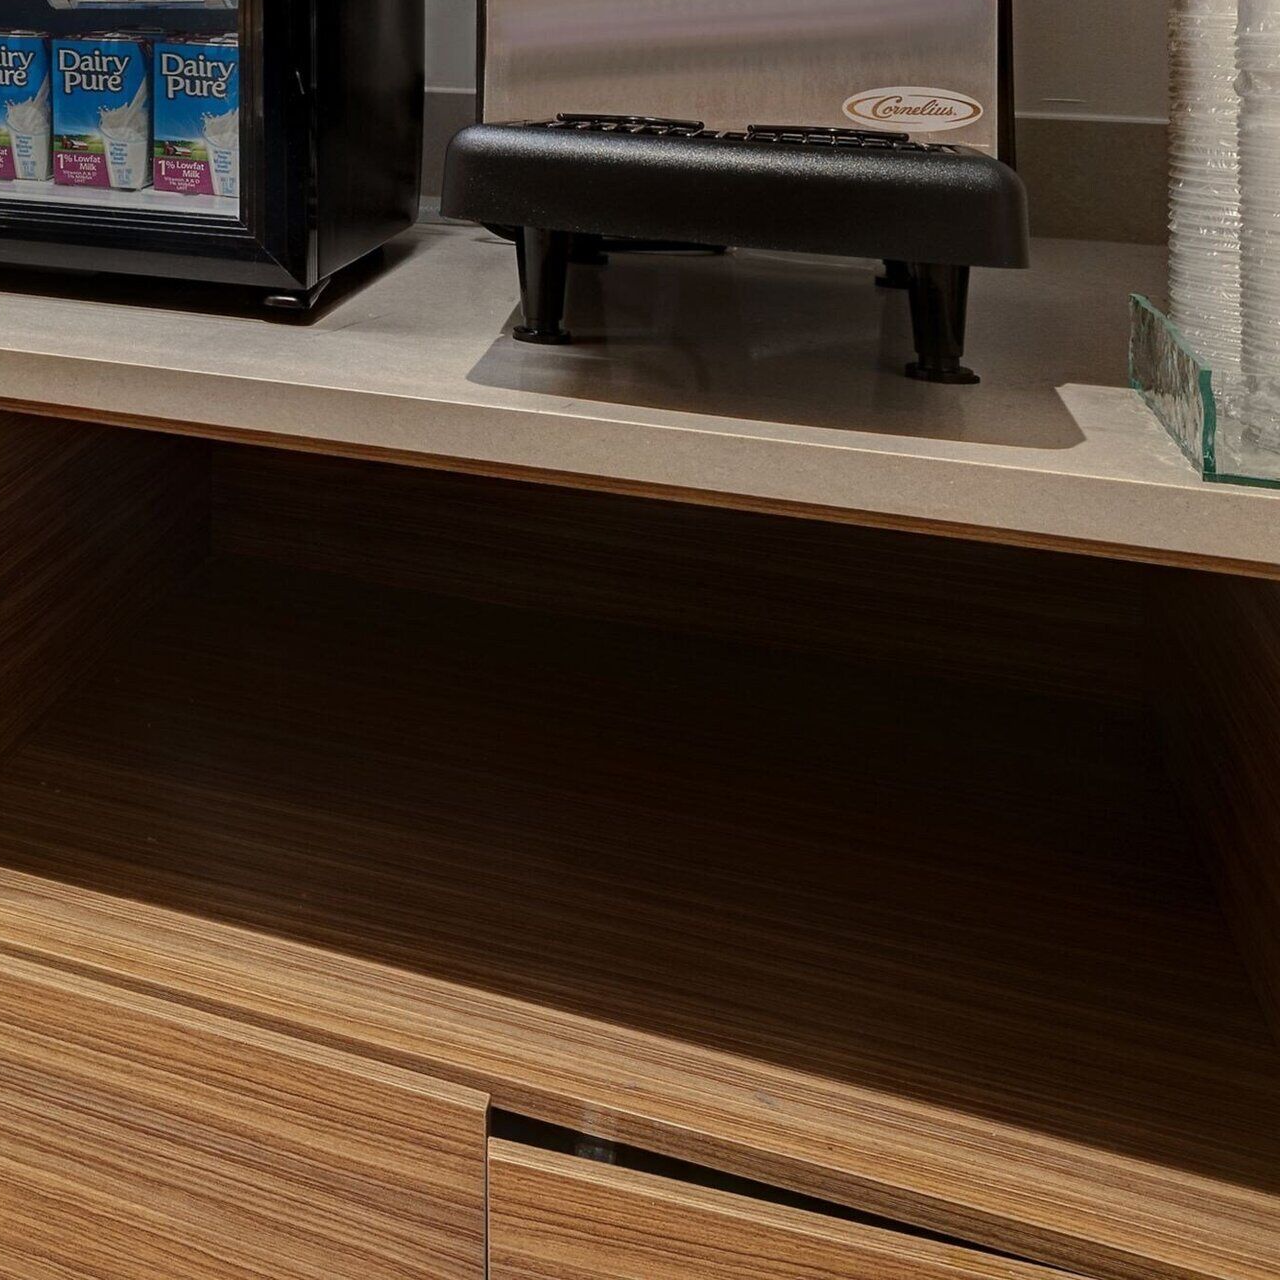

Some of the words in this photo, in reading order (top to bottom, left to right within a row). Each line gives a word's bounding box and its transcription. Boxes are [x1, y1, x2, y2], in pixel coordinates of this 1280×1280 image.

[59, 49, 129, 75] Dairy
[161, 53, 234, 81] Dairy
[64, 71, 122, 94] Pure
[167, 76, 226, 99] Pure
[57, 153, 73, 169] 1%
[73, 154, 101, 164] Lowfat
[80, 163, 97, 171] Milk
[158, 160, 176, 176] 1%
[176, 161, 205, 171] Lowfat
[182, 170, 200, 179] Milk
